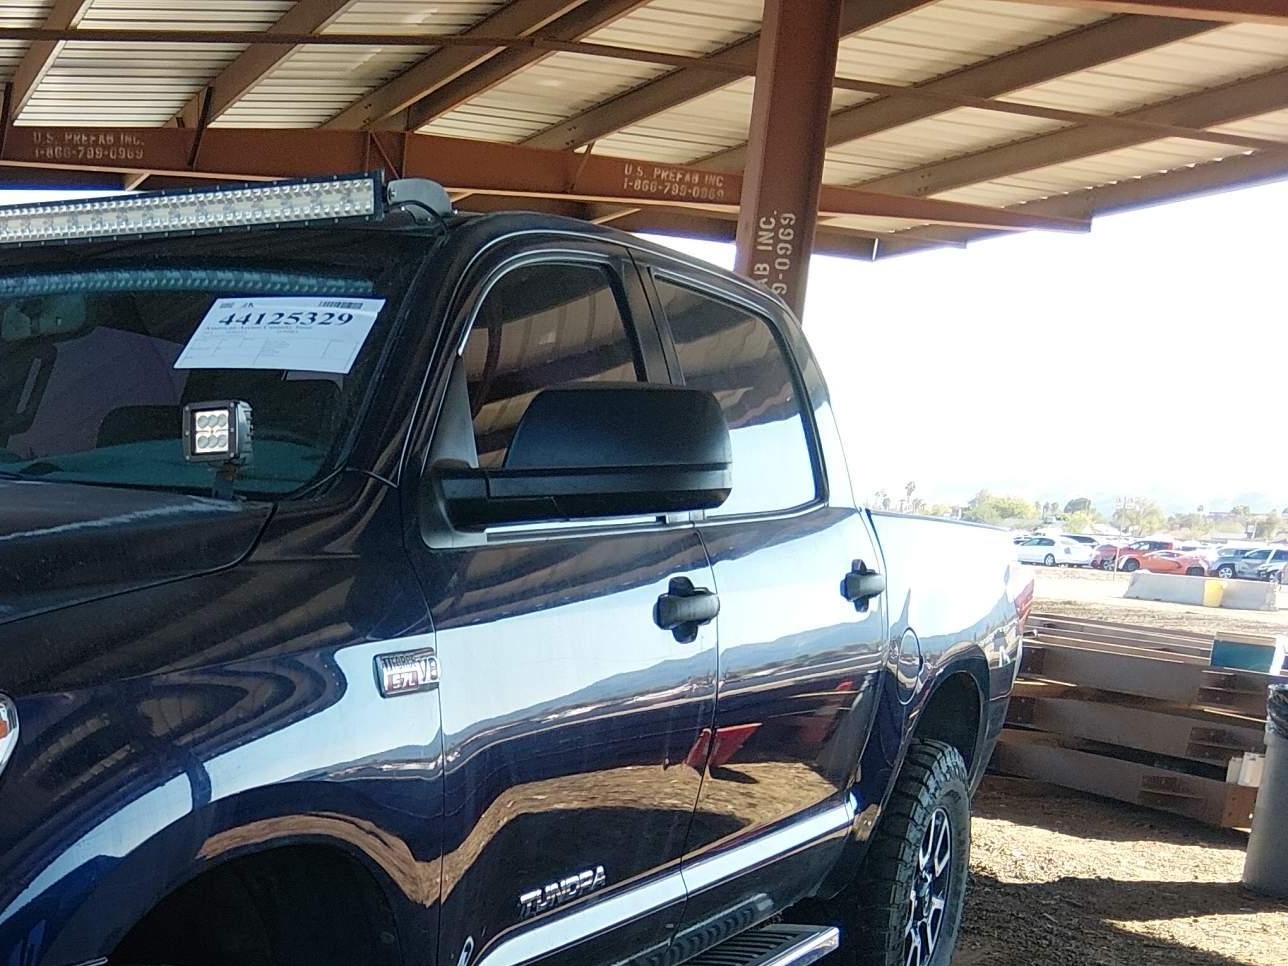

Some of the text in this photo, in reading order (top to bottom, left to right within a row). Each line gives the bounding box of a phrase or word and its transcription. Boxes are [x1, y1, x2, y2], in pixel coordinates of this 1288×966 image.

[64, 131, 114, 145] PREFAB
[120, 132, 145, 146] INC.
[653, 167, 700, 184] PREFAB
[756, 210, 778, 251] INC.
[218, 312, 353, 326] 44125329
[518, 865, 606, 918] TUNDRA
